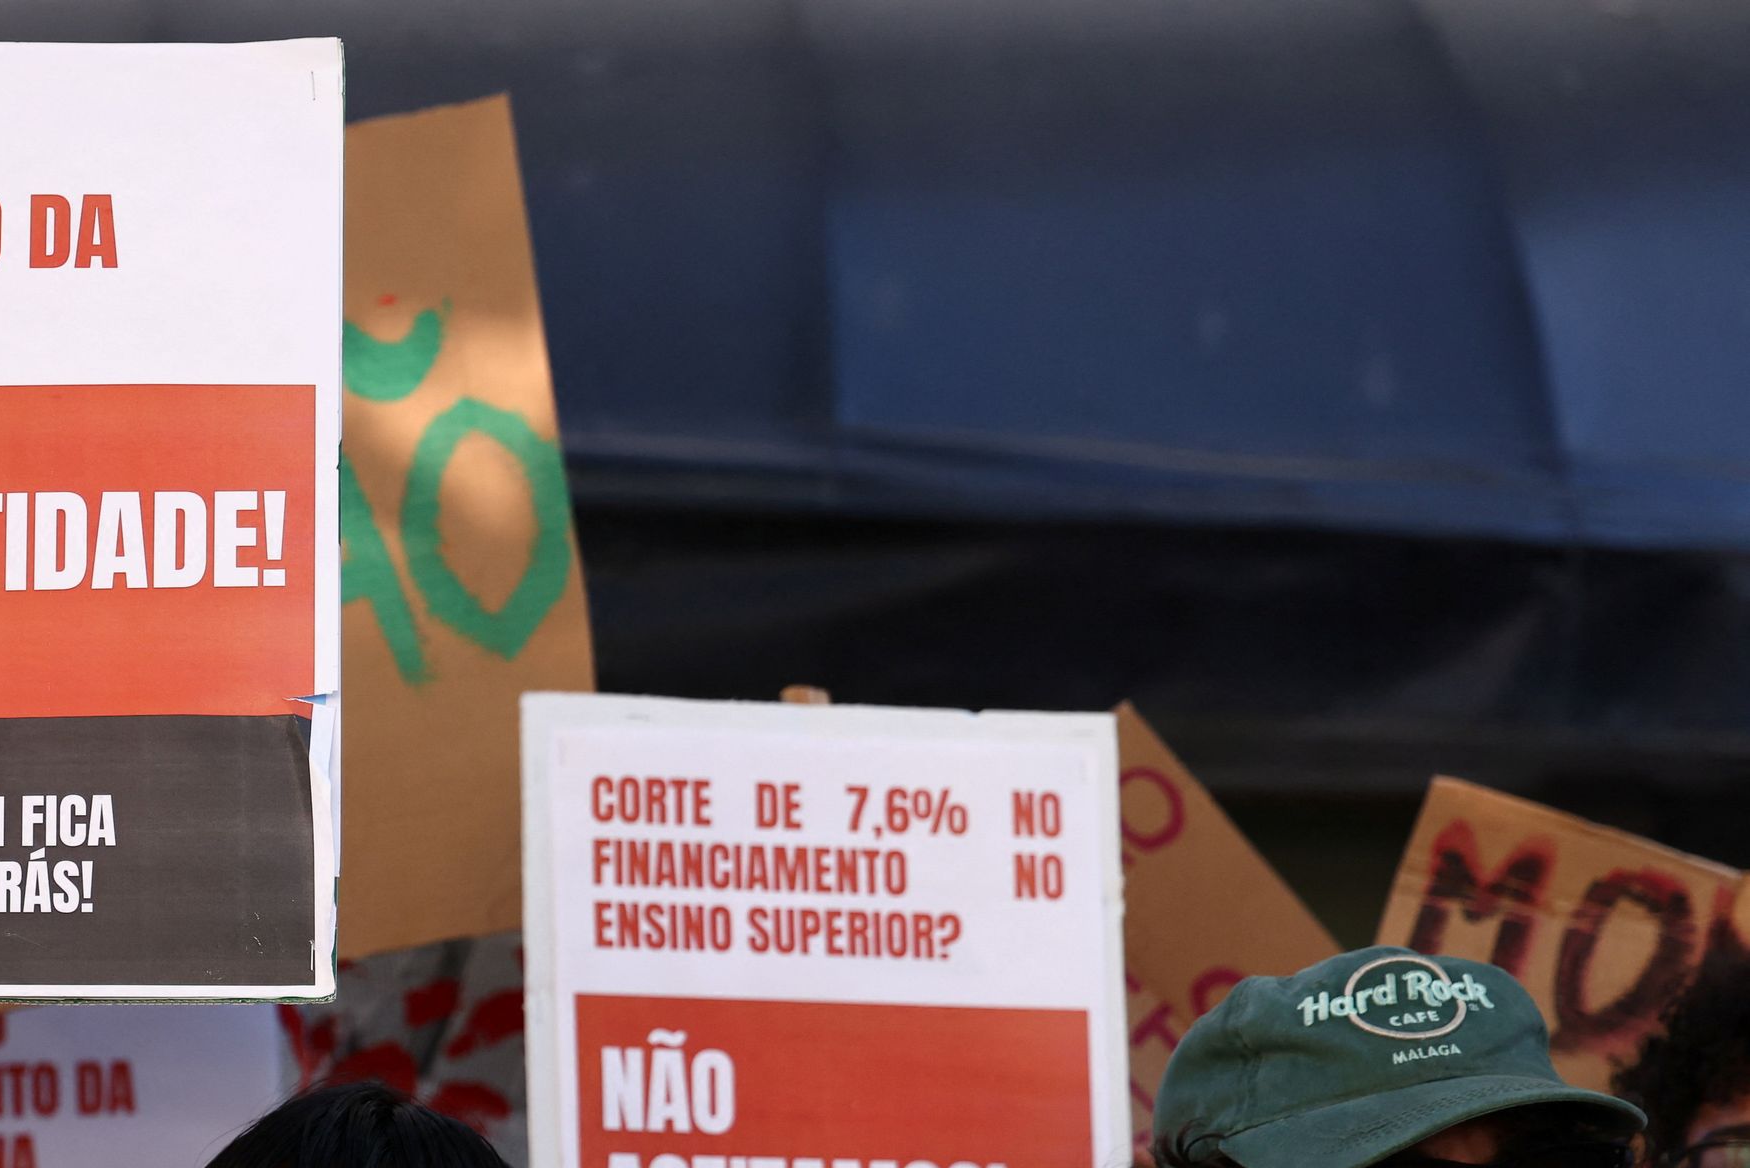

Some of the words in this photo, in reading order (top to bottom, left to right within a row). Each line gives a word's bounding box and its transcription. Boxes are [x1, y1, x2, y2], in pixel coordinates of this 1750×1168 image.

[29, 194, 118, 269] DA
[21, 794, 117, 849] FICA
[591, 775, 712, 827] CORTE
[756, 783, 802, 829] DE
[846, 786, 969, 841] 7,6%
[1012, 791, 1063, 838] NO
[593, 839, 908, 895] FINANCIAMENTO
[1014, 853, 1064, 901] NO
[594, 900, 732, 953] ENSINO
[749, 905, 962, 960] SUPERIOR?
[1297, 973, 1398, 1026] Hard
[1402, 970, 1494, 1009] Rock
[1389, 1010, 1440, 1027] CAFE
[600, 1029, 736, 1135] NÃO
[1392, 1044, 1461, 1065] MALAGA
[76, 1060, 136, 1116] DA
